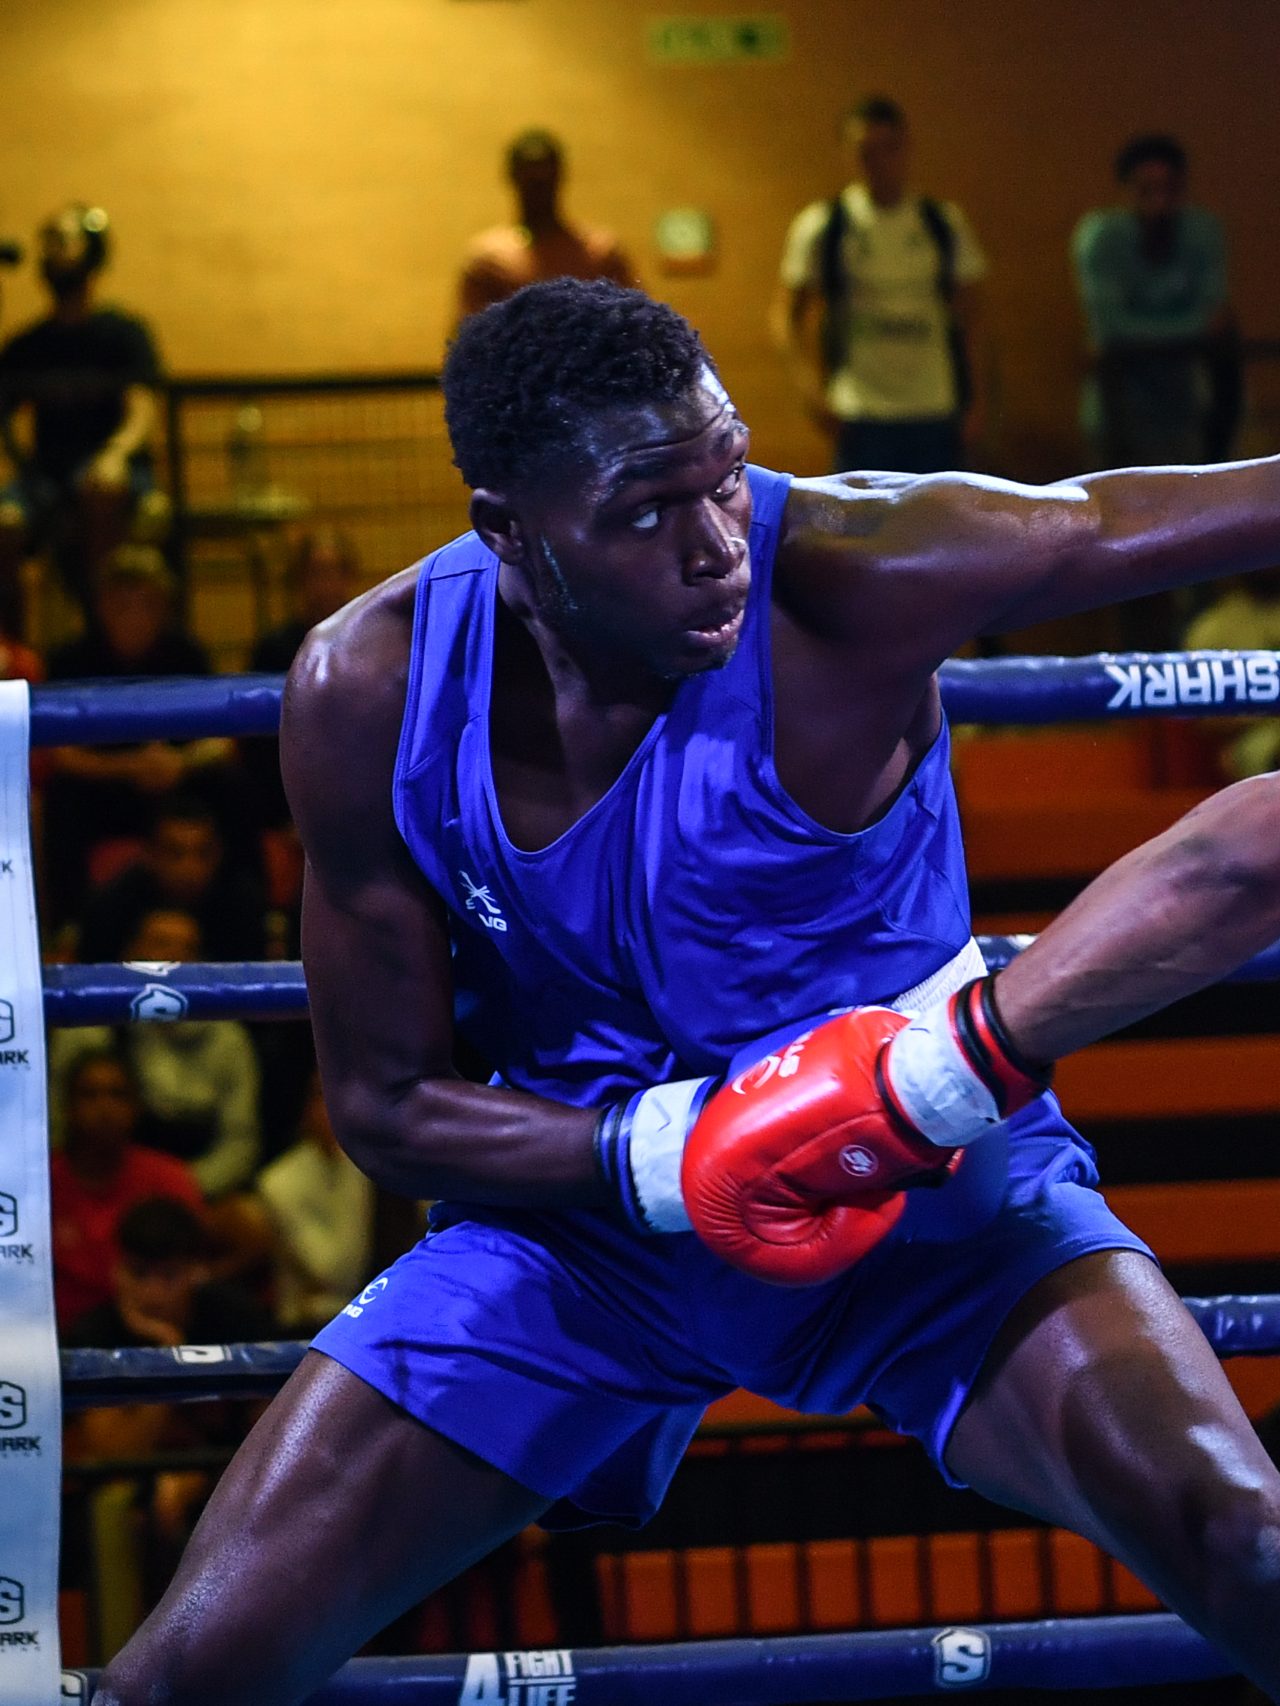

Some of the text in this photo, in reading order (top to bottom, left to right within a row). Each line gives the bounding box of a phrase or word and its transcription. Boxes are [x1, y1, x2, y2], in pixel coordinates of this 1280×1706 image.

[1104, 658, 1280, 709] SHARK
[458, 1650, 573, 1706] 4 FIGHT
